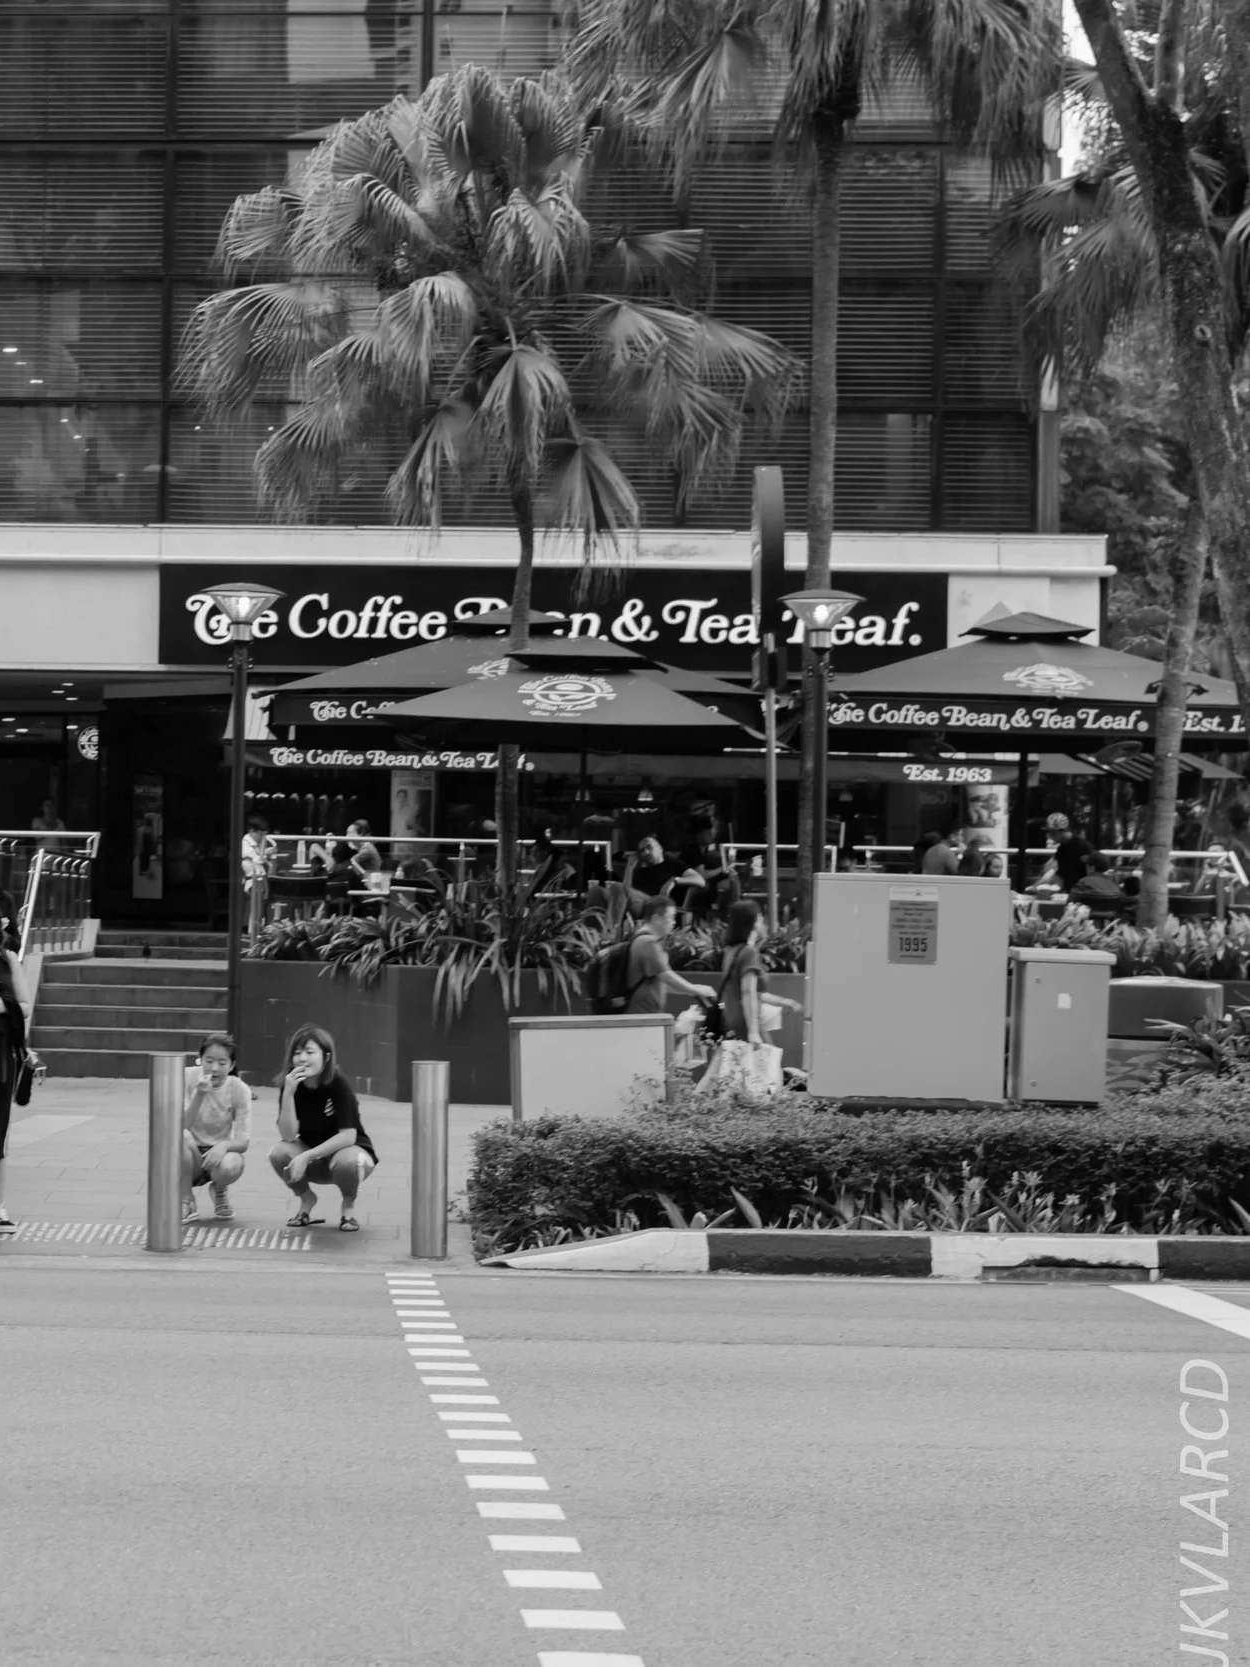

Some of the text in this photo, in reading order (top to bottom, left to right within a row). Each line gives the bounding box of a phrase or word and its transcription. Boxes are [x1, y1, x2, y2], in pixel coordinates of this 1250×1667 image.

[288, 593, 448, 640] Coffee
[611, 598, 659, 642] &
[661, 598, 760, 644] Tea
[310, 700, 347, 721] The
[868, 703, 940, 725] Coffee
[941, 705, 1011, 731] Bean
[1032, 708, 1076, 730] Tea
[270, 747, 303, 766] The
[306, 750, 364, 765] Coffee
[365, 750, 422, 769] Bean
[439, 751, 476, 768] Tea
[902, 764, 992, 782] Est. 1963
[899, 937, 927, 952] 1995
